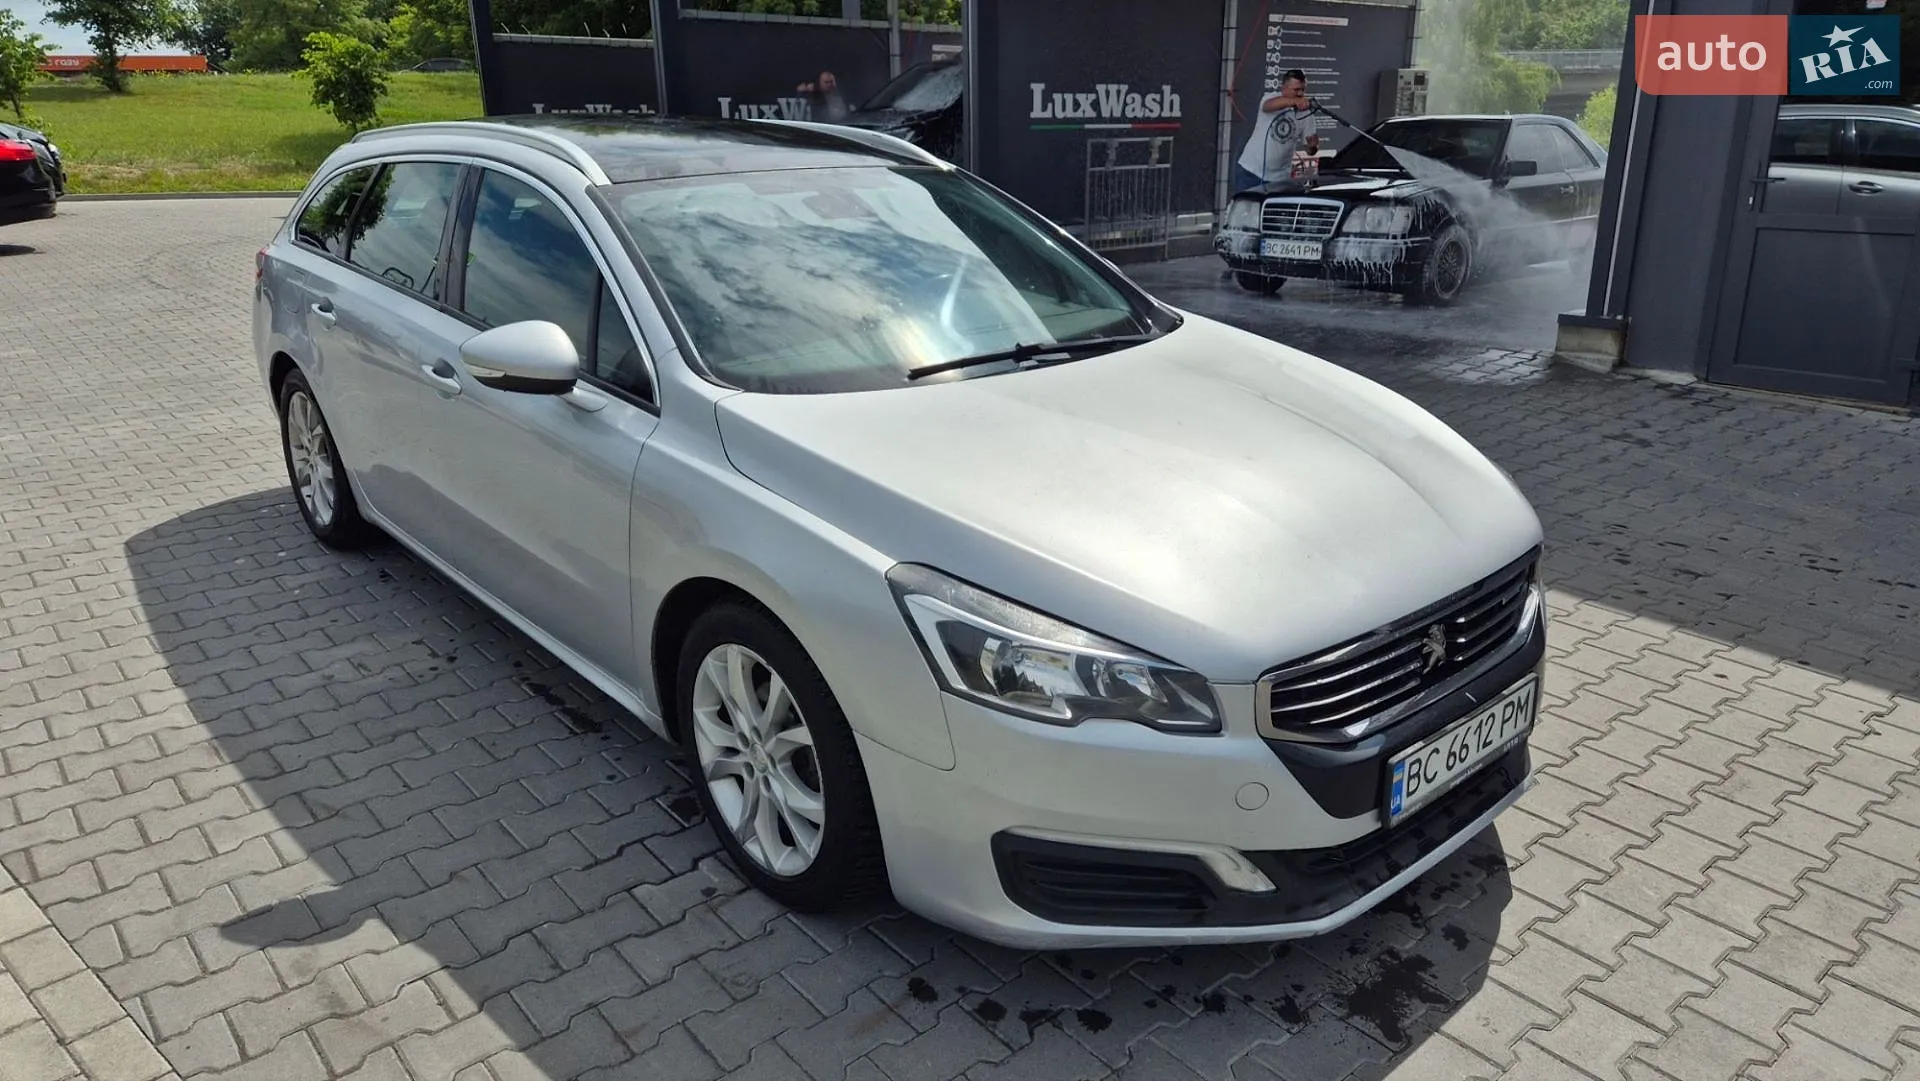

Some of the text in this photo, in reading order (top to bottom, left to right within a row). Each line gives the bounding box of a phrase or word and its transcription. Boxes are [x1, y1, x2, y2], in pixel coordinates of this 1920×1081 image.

[1030, 83, 1182, 119] LuxWash
[1267, 243, 1278, 254] BC
[1304, 245, 1319, 256] PM
[1406, 747, 1440, 798] BC
[1446, 712, 1496, 772] 6612
[1500, 688, 1531, 739] PM
